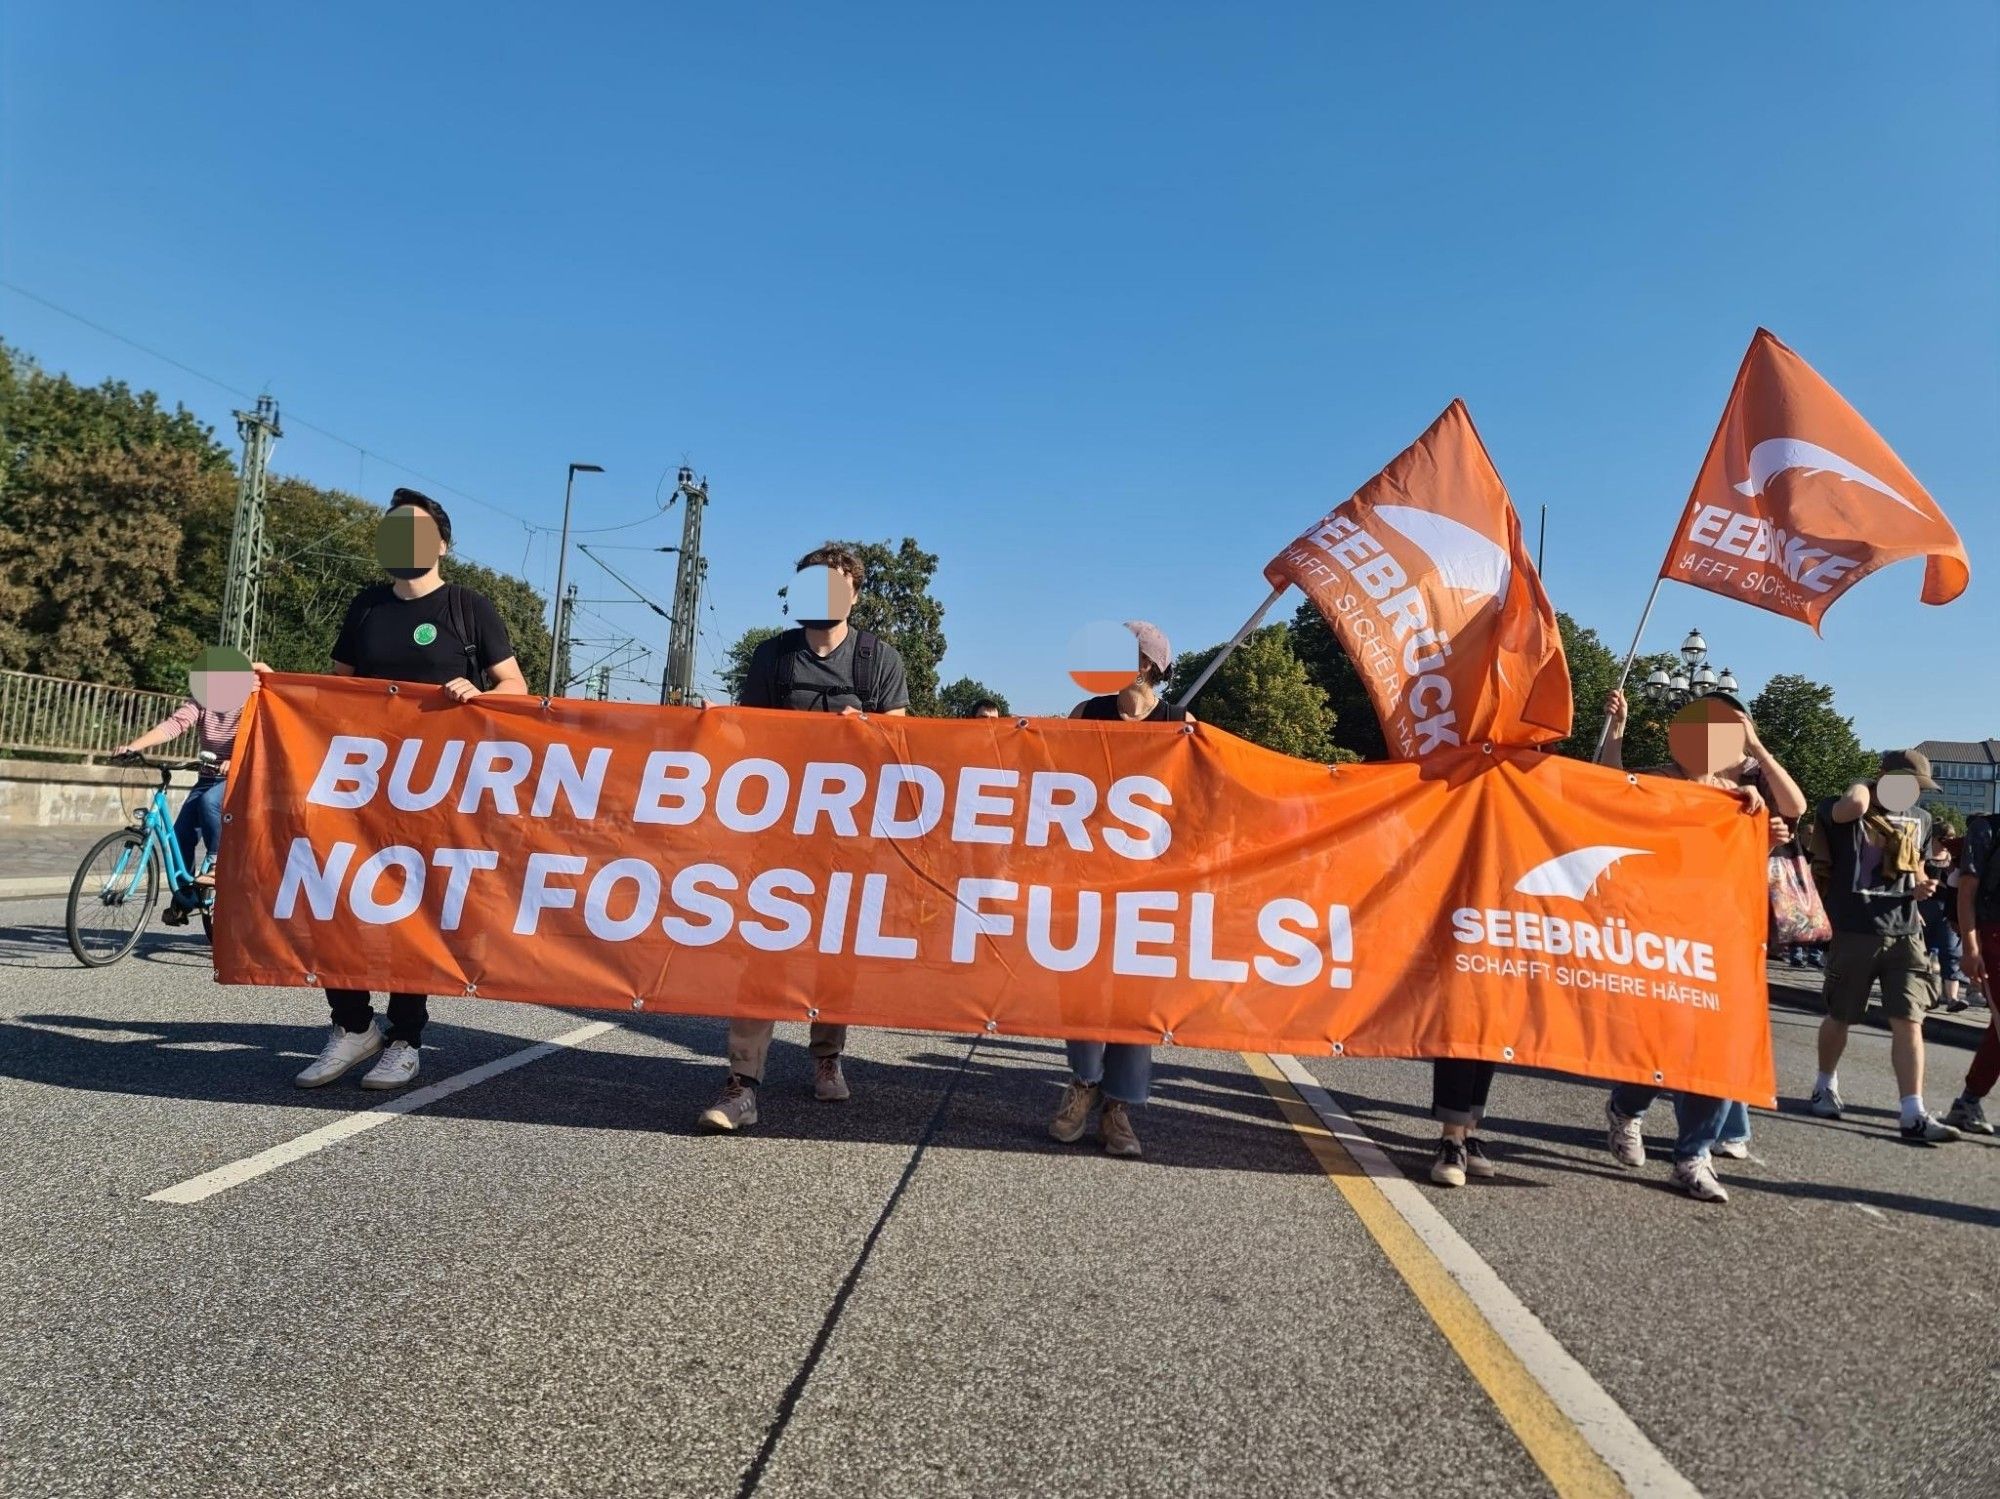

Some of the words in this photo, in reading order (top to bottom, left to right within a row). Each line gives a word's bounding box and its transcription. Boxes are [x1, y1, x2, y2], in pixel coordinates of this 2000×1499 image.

[1680, 552, 1739, 581] AFFT
[1336, 594, 1402, 711] SICHERE
[306, 735, 612, 820] BURN
[633, 751, 1173, 860] BORDERS
[274, 838, 499, 931] NOT
[513, 853, 918, 962] FOSSIL
[951, 878, 1354, 988] FUELS!
[1452, 907, 1717, 983] SEEBRÜCKE
[1455, 954, 1550, 981] SCHAFFT
[1556, 966, 1646, 998] SICHERE
[1652, 982, 1720, 1011] HÄFEN!
